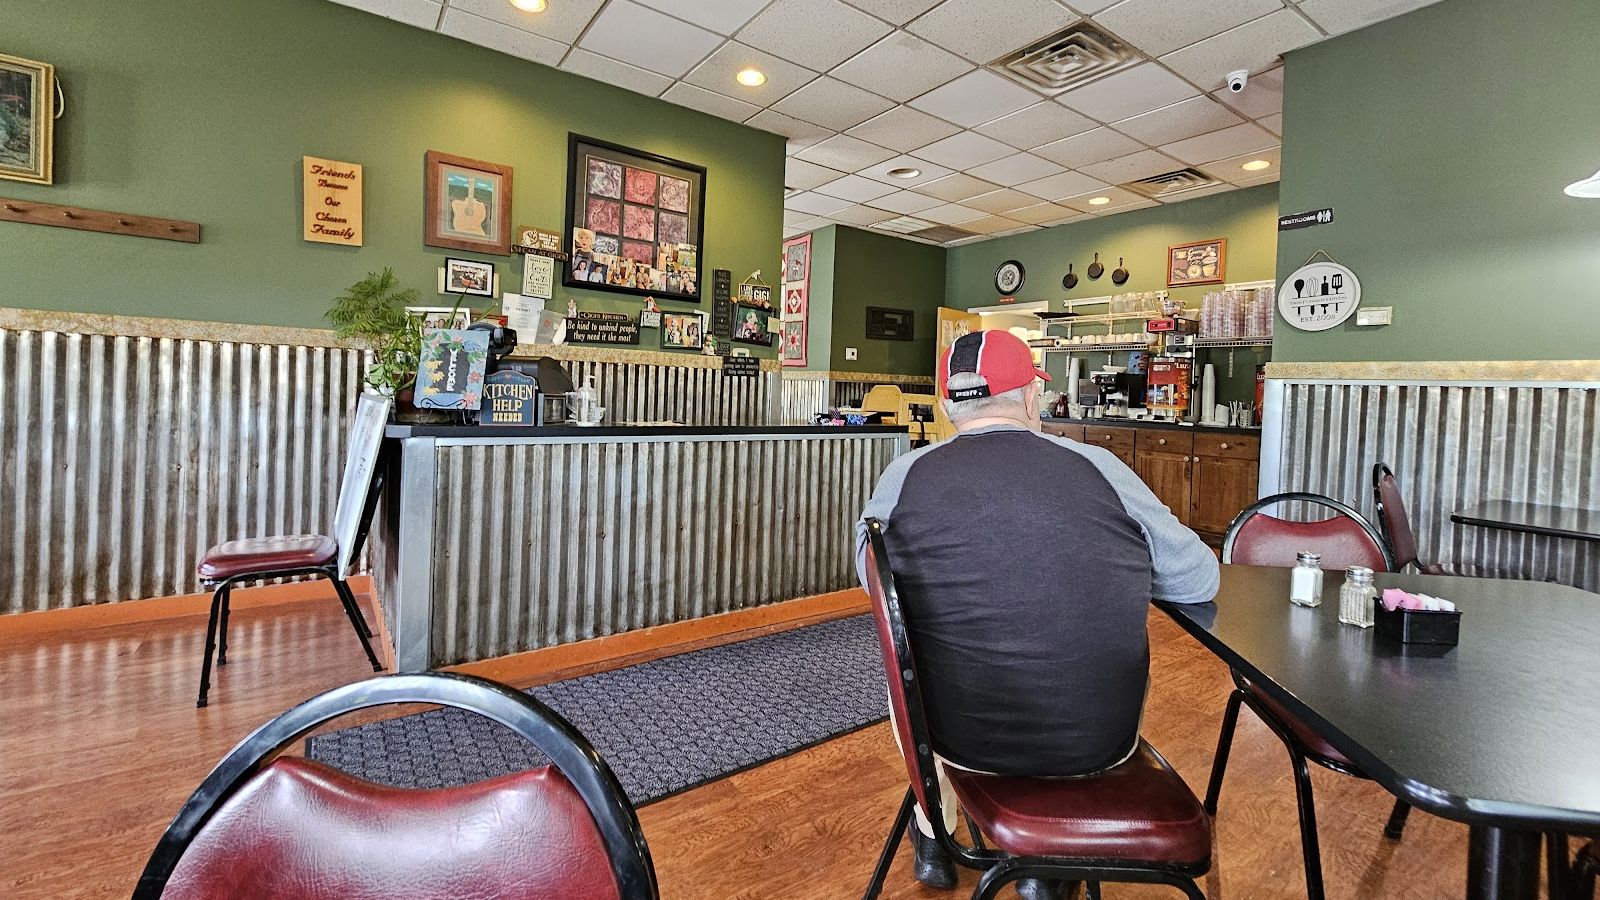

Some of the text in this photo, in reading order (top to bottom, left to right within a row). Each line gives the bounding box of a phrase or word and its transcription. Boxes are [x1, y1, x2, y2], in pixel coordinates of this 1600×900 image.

[310, 164, 356, 180] Friends
[324, 196, 341, 207] Our
[315, 211, 347, 224] Chosen
[310, 223, 355, 240] Family
[753, 289, 770, 302] GIGI
[1300, 315, 1315, 323] EST.
[567, 320, 638, 334] Be kind to unkind people,
[573, 330, 586, 342] they
[586, 331, 600, 341] need
[601, 332, 607, 341] it
[608, 332, 617, 342] the
[446, 348, 459, 392] WELCOME
[483, 383, 533, 400] KITCHEN
[493, 399, 523, 412] HELP
[493, 412, 523, 422] NEEDED
